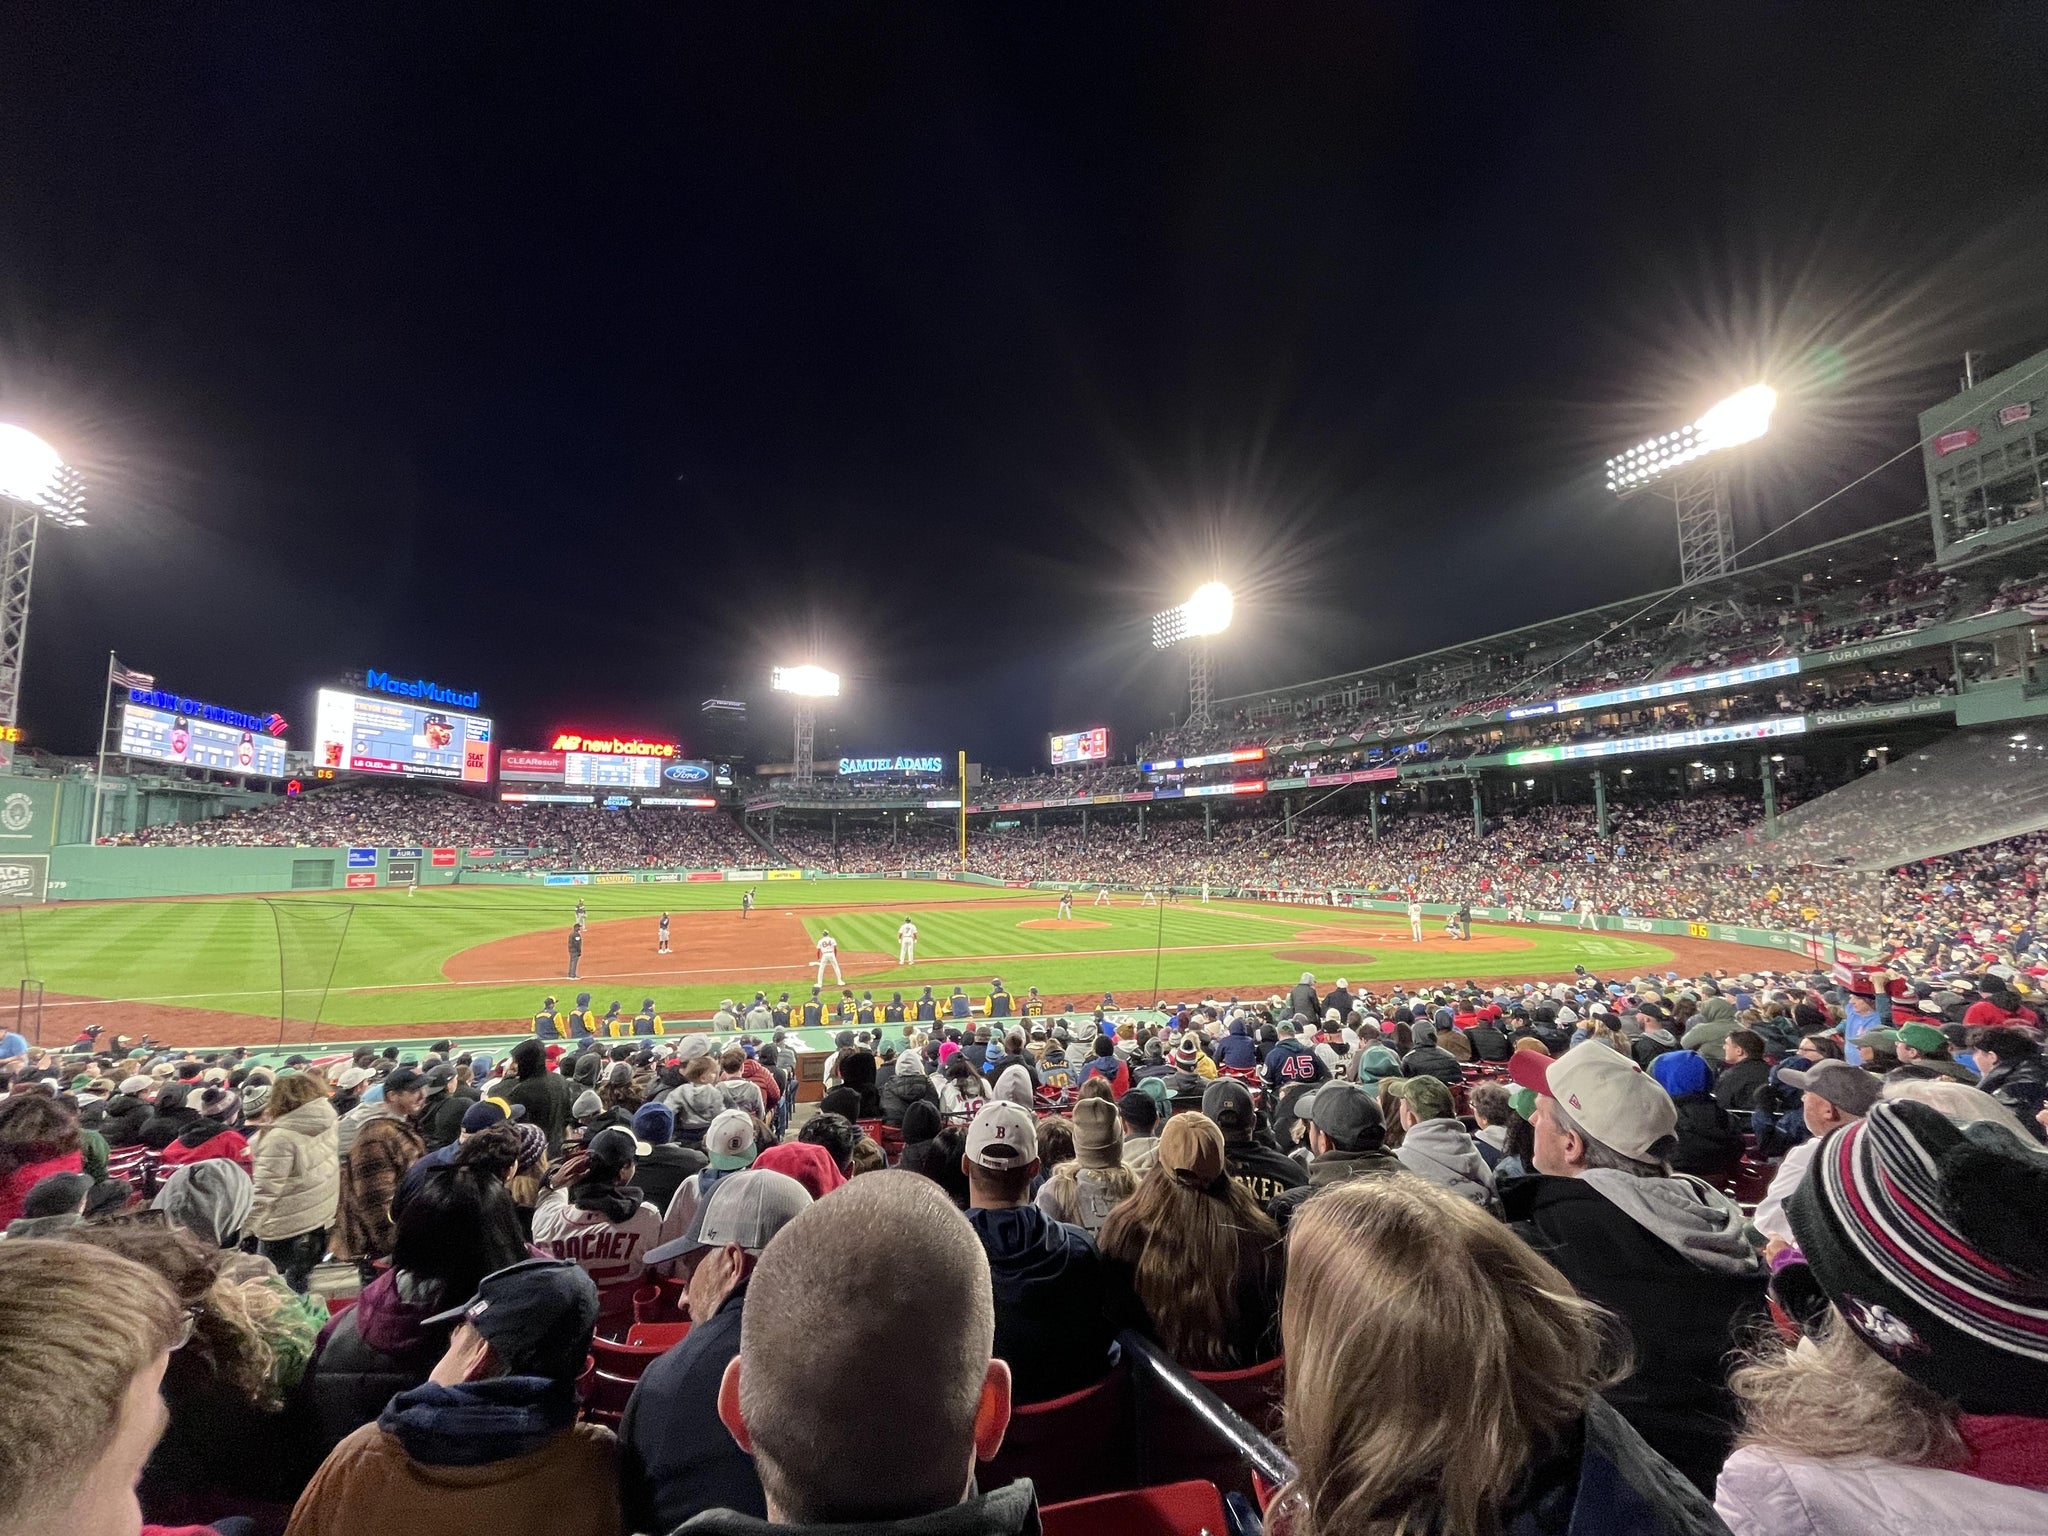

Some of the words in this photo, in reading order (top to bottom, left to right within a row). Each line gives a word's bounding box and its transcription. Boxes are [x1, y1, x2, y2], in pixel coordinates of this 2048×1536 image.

[1861, 639, 1912, 655] PAVILION
[367, 669, 479, 709] MassMutual
[130, 688, 179, 712] BANK
[180, 699, 201, 716] OF
[203, 704, 263, 732] AMERICA
[1912, 701, 1941, 713] Level
[613, 738, 674, 757] balance
[468, 752, 484, 760] SEAT
[467, 760, 484, 768] GEEK
[839, 758, 893, 775] SAMUEL
[894, 756, 943, 773] ADAMS
[672, 768, 700, 780] Ford
[844, 1003, 856, 1013] 22
[1281, 1055, 1314, 1079] 45
[995, 1126, 1005, 1138] B
